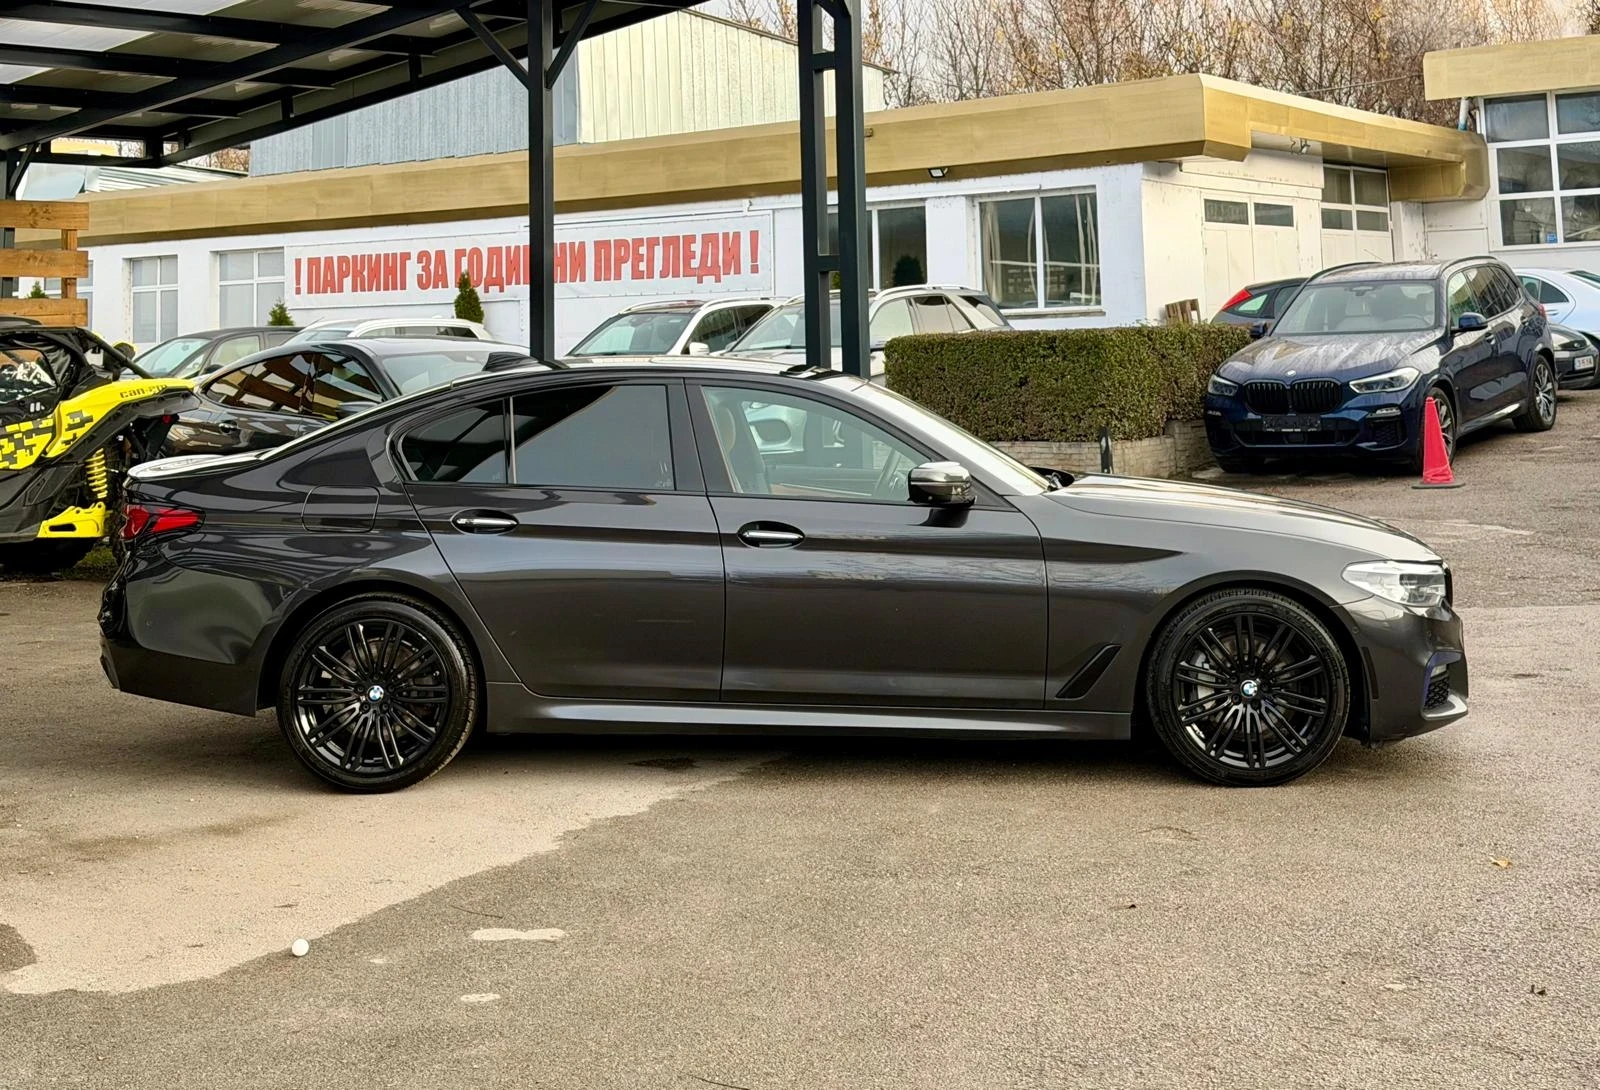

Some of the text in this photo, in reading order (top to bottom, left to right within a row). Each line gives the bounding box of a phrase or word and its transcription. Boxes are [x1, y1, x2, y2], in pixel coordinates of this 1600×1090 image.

[307, 252, 411, 295] ПАРКИНГ
[416, 249, 449, 290] ЗА
[454, 240, 587, 293] ГОДИНИ
[593, 231, 741, 284] ПРЕГЛЕДИ
